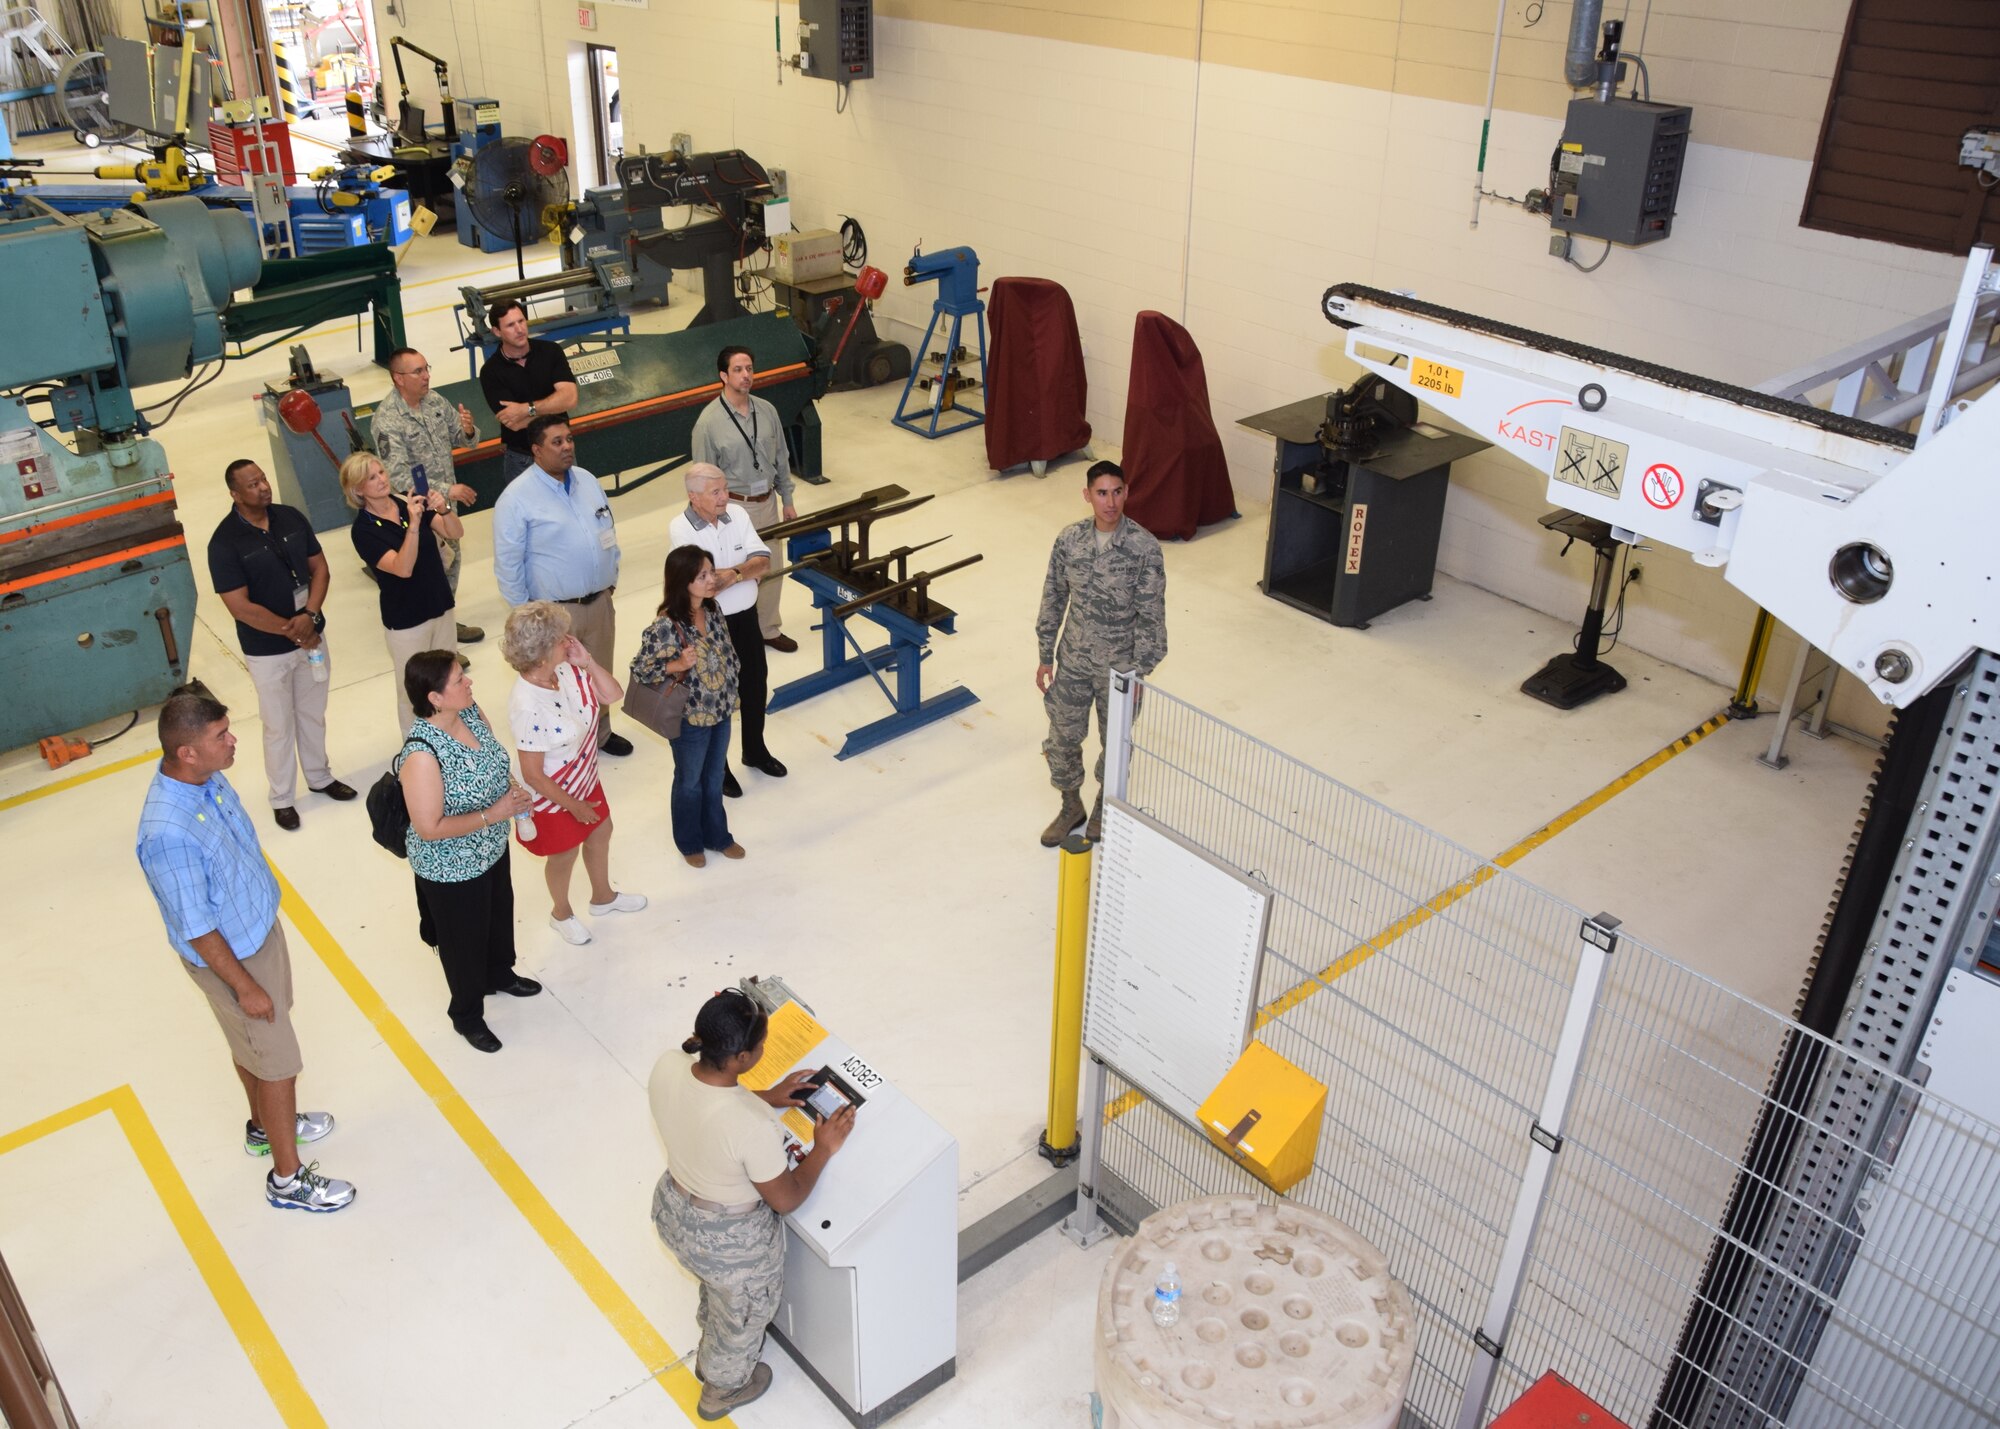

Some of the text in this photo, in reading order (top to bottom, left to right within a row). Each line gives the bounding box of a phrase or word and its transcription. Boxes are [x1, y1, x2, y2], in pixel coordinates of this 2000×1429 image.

[578, 9, 590, 27] EXIT
[572, 352, 612, 372] ATIONAL
[1428, 364, 1449, 379] 1,0 t
[579, 370, 613, 385] AG 4016
[1418, 375, 1454, 395] 2205 lb
[1498, 419, 1557, 451] KAST
[1348, 508, 1364, 571] ROTEX
[840, 1055, 883, 1090] AG0827
